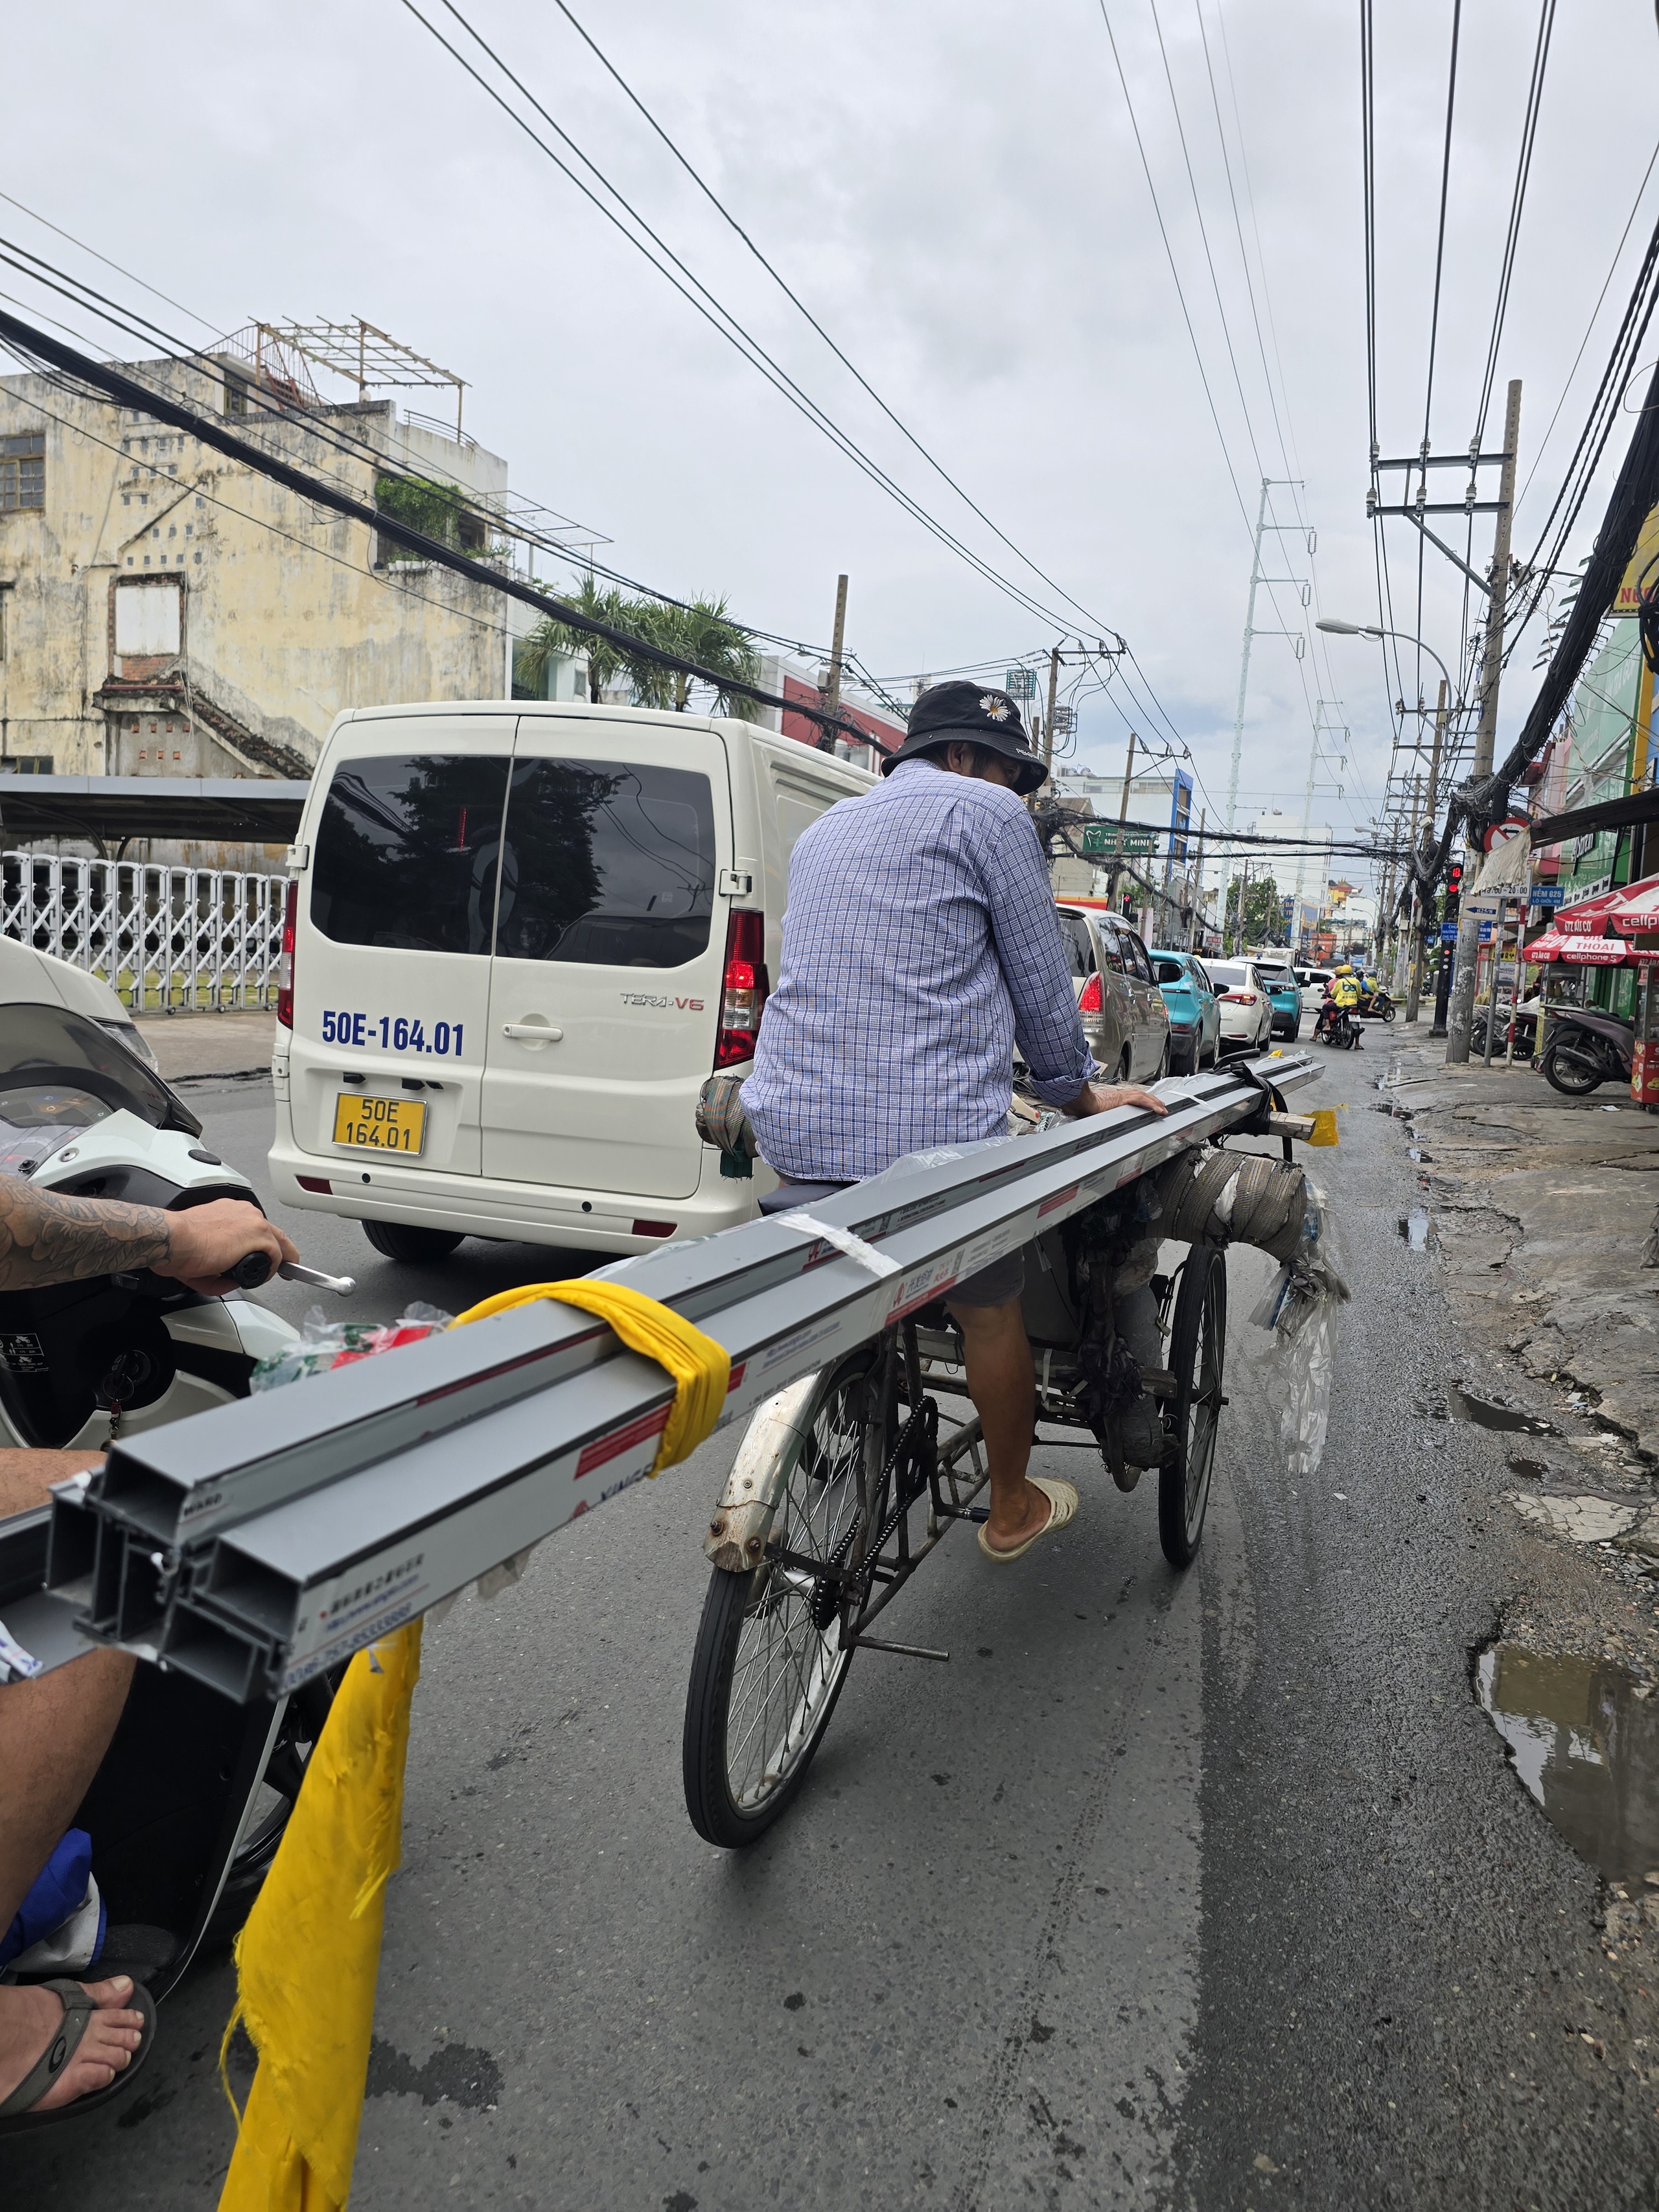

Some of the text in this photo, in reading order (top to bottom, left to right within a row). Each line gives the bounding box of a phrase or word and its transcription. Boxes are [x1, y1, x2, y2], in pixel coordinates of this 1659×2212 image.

[1622, 914, 1659, 929] cellp
[1575, 942, 1614, 952] THOẠI
[1566, 953, 1609, 961] cellphone
[1342, 981, 1357, 992] be
[620, 992, 705, 1011] TERA-V6
[323, 1010, 463, 1056] 50E-164.01
[361, 1099, 400, 1123] 50E
[346, 1121, 411, 1150] 164.01
